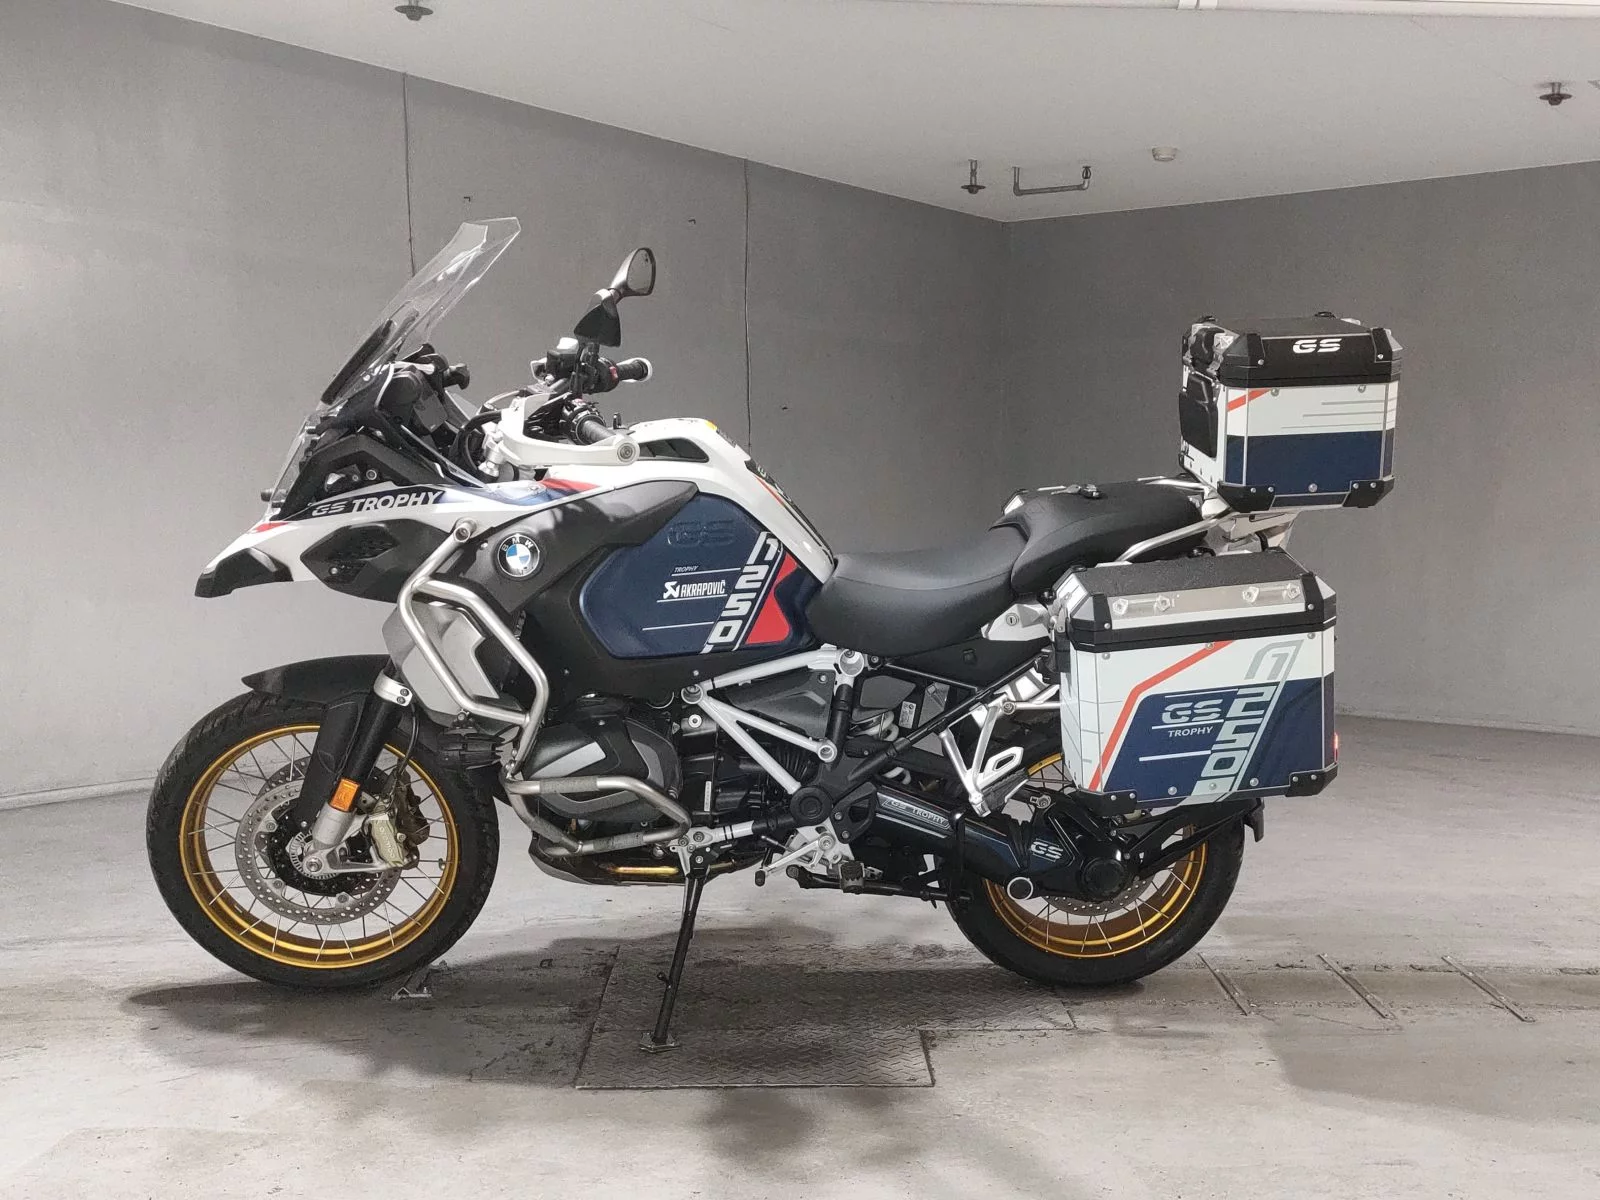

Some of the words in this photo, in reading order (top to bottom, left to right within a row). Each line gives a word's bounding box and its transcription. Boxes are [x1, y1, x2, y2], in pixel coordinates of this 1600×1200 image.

[1292, 338, 1342, 354] GS
[311, 500, 346, 517] GS
[350, 490, 445, 514] TROPHY
[501, 535, 534, 552] BMW
[674, 565, 699, 573] TROPHY
[1161, 698, 1224, 724] GS
[1167, 725, 1214, 738] TROPHY
[912, 807, 947, 825] TROPHY
[1030, 840, 1064, 860] GS
